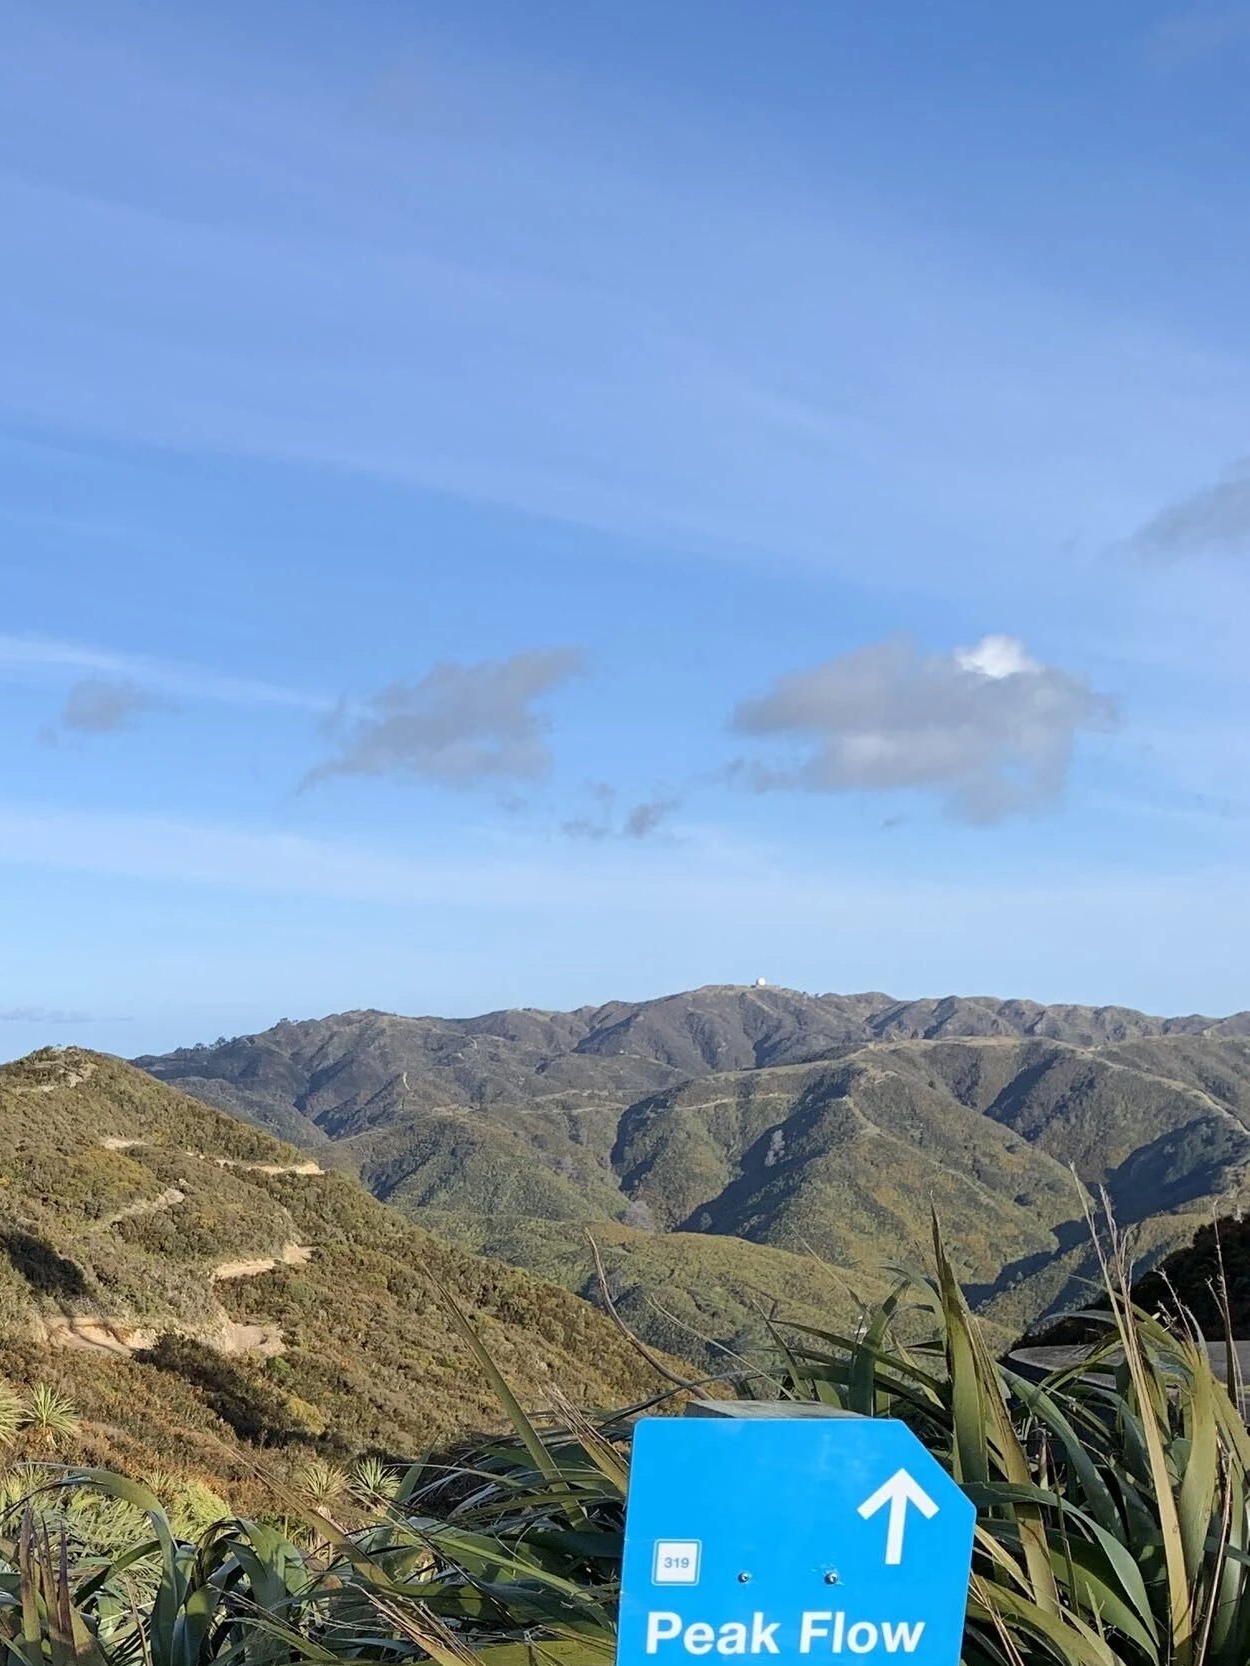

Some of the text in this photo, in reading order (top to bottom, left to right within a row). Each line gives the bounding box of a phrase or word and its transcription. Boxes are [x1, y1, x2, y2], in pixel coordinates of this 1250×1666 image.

[663, 1555, 690, 1570] 319
[645, 1611, 927, 1655] Peak Flow
